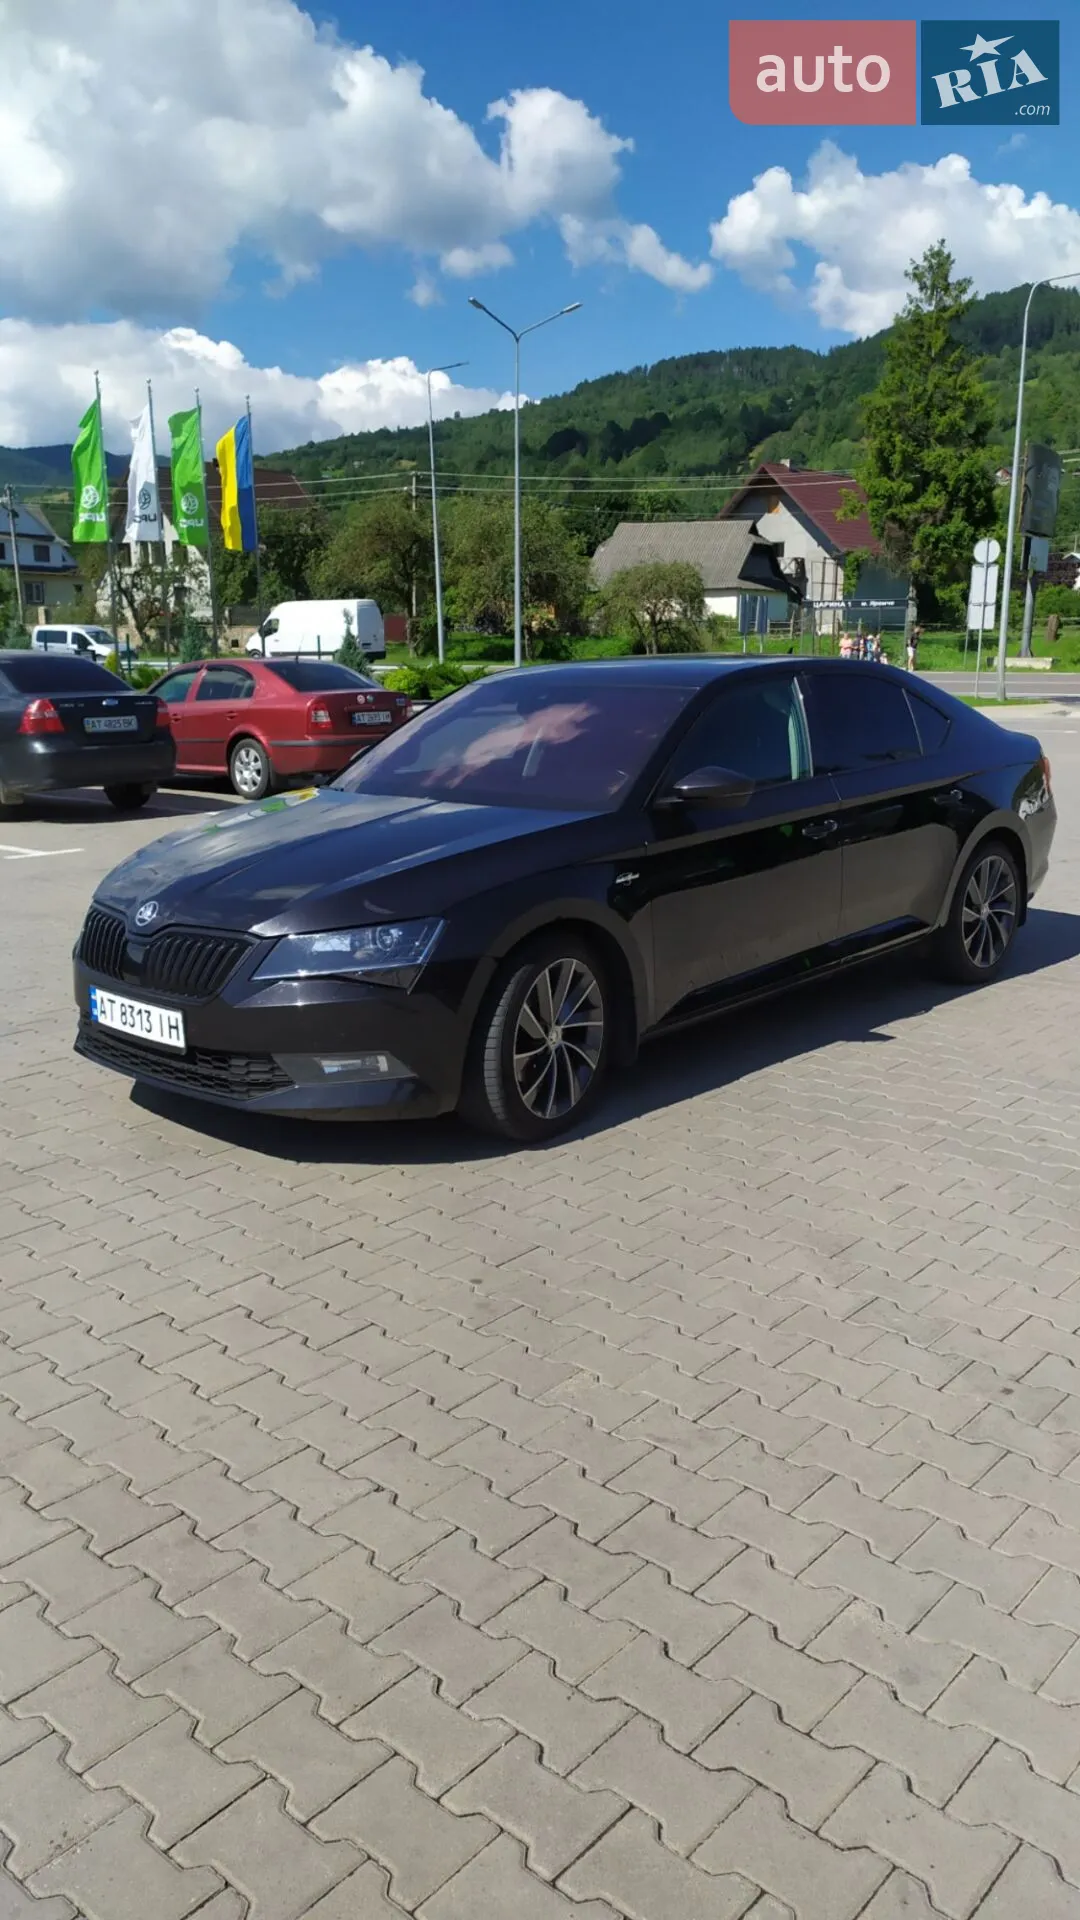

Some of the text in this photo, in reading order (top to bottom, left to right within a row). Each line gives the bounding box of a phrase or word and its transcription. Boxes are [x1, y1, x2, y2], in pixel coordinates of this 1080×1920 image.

[100, 997, 180, 1041] AT 8313 IH
